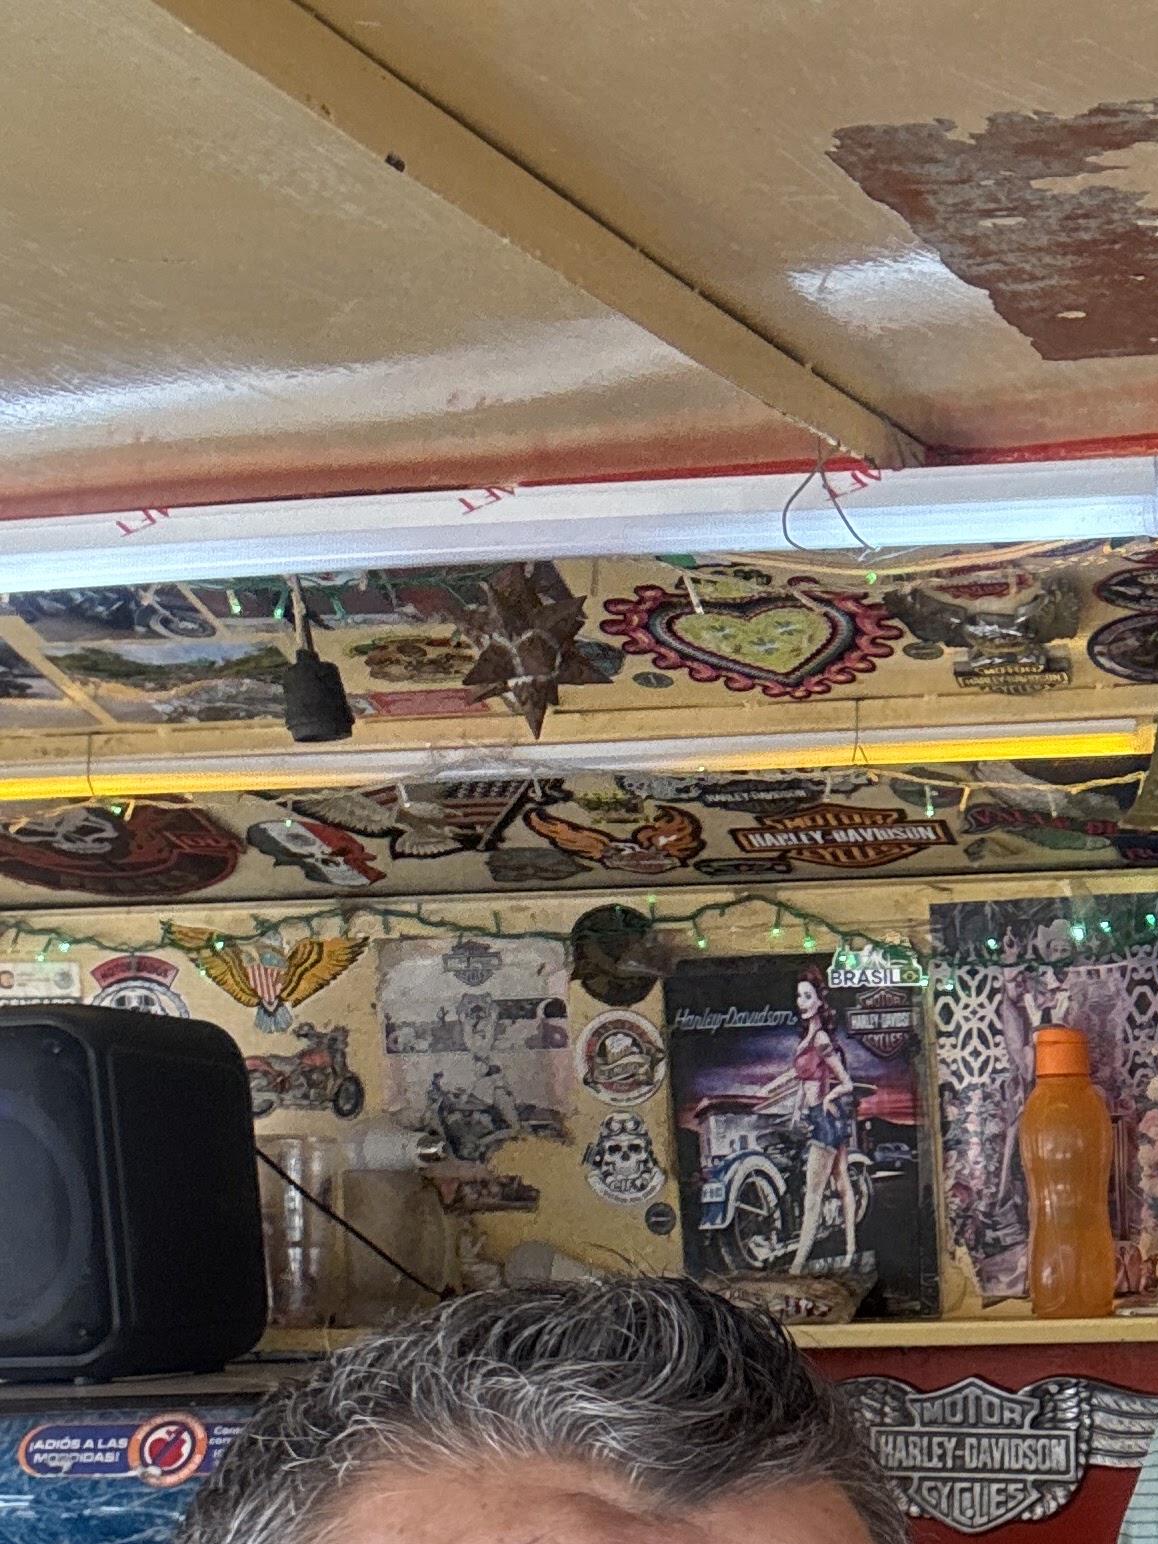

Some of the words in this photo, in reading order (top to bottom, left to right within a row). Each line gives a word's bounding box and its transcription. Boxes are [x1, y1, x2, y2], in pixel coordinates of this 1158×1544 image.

[747, 825, 938, 849] HARLEY-DAVIDSON
[830, 968, 900, 986] BRASIL
[923, 1387, 1023, 1425] MOTOR
[83, 1438, 95, 1449] A
[97, 1437, 129, 1449] LAS
[879, 1434, 1068, 1472] HARLEY-DAVIDSON
[921, 1481, 1026, 1527] CYCLES
